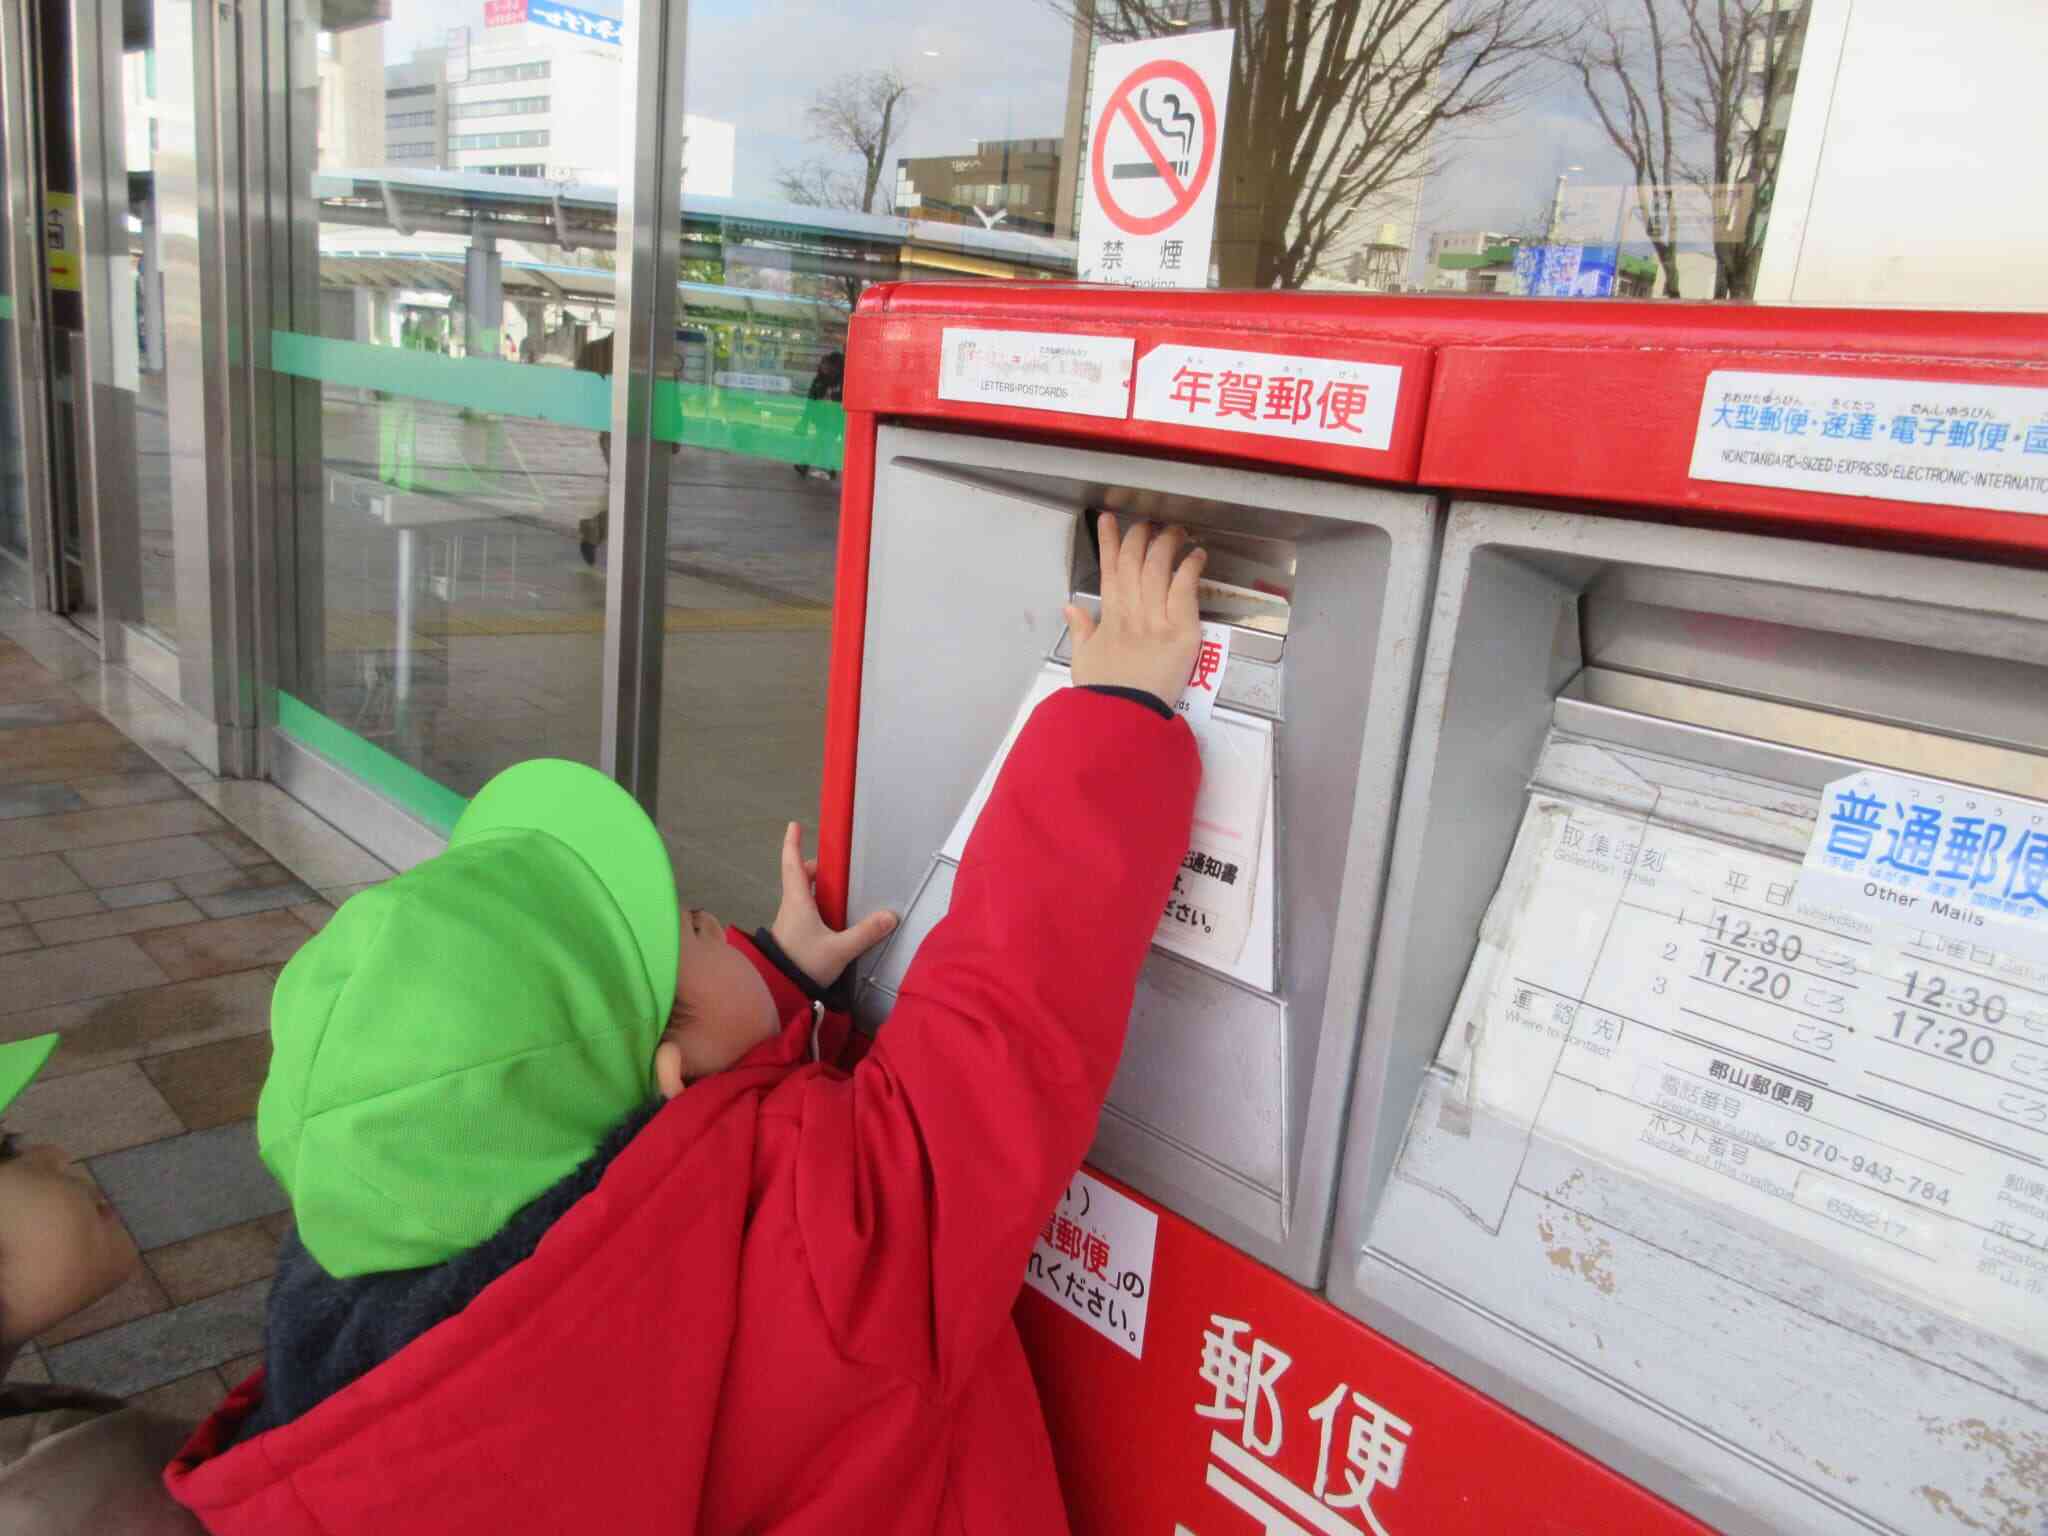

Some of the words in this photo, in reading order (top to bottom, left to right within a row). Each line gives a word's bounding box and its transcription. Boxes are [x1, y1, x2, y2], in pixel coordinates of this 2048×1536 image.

[1169, 364, 1370, 434] 年賀郵便
[1863, 882, 1919, 908] Other
[1930, 900, 1985, 927] Mails
[1661, 942, 1679, 961] 2
[1714, 912, 1803, 962] 12:30
[1652, 976, 1668, 995] 3
[1704, 951, 1791, 1000] 17:20
[1904, 970, 2008, 1025] 12:30
[1892, 1010, 1995, 1066] 17:20
[1708, 1058, 1815, 1113] 郡山郵便局
[1784, 1129, 1952, 1207] 0570-943-784
[1193, 1313, 1414, 1536] 郵便
